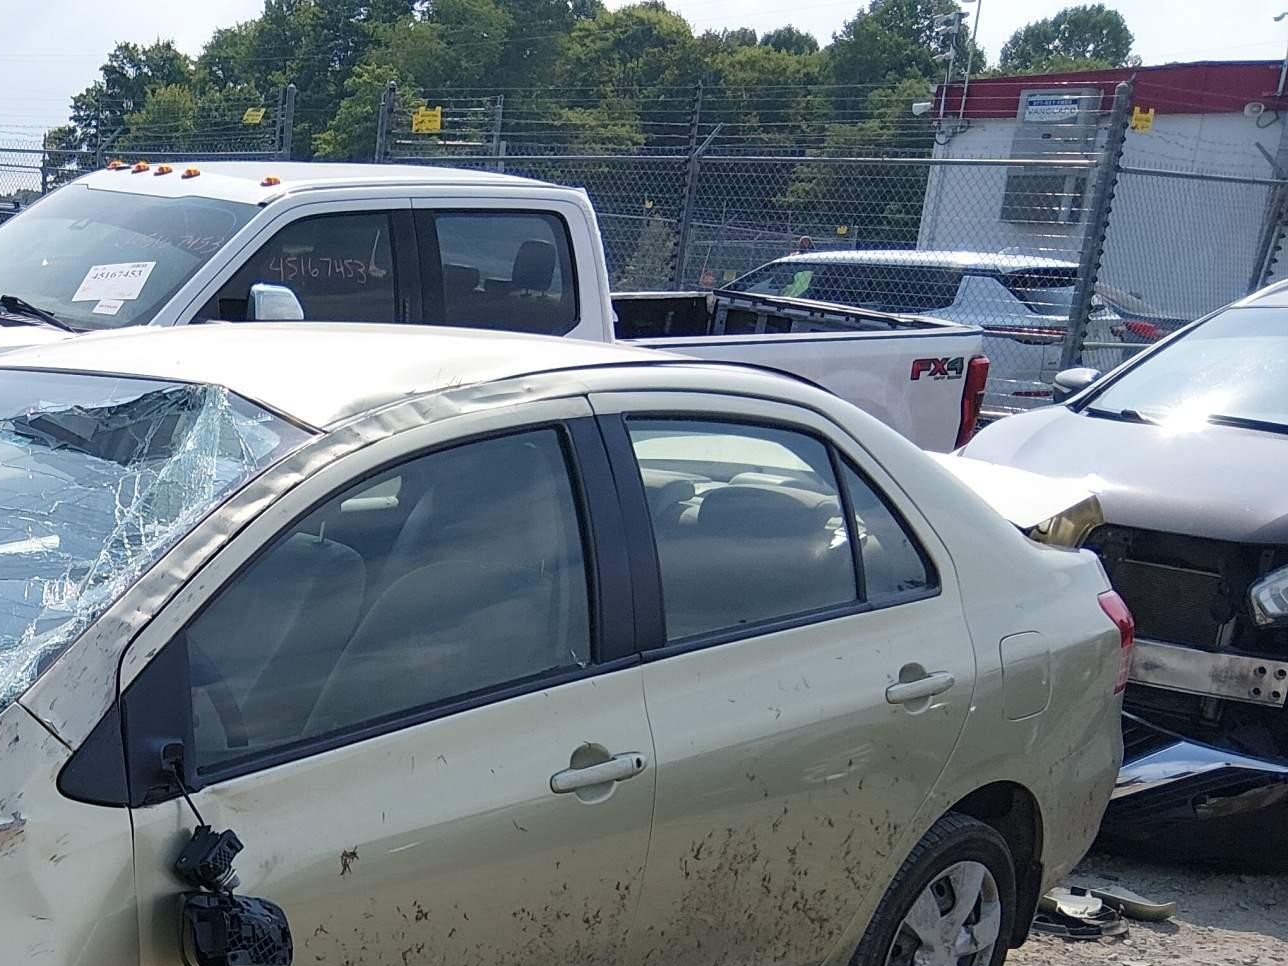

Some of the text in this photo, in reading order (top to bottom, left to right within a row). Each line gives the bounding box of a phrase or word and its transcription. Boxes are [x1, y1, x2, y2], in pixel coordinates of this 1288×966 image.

[91, 270, 143, 280] 45167453
[268, 256, 367, 284] 45167453
[910, 356, 965, 381] FX4
